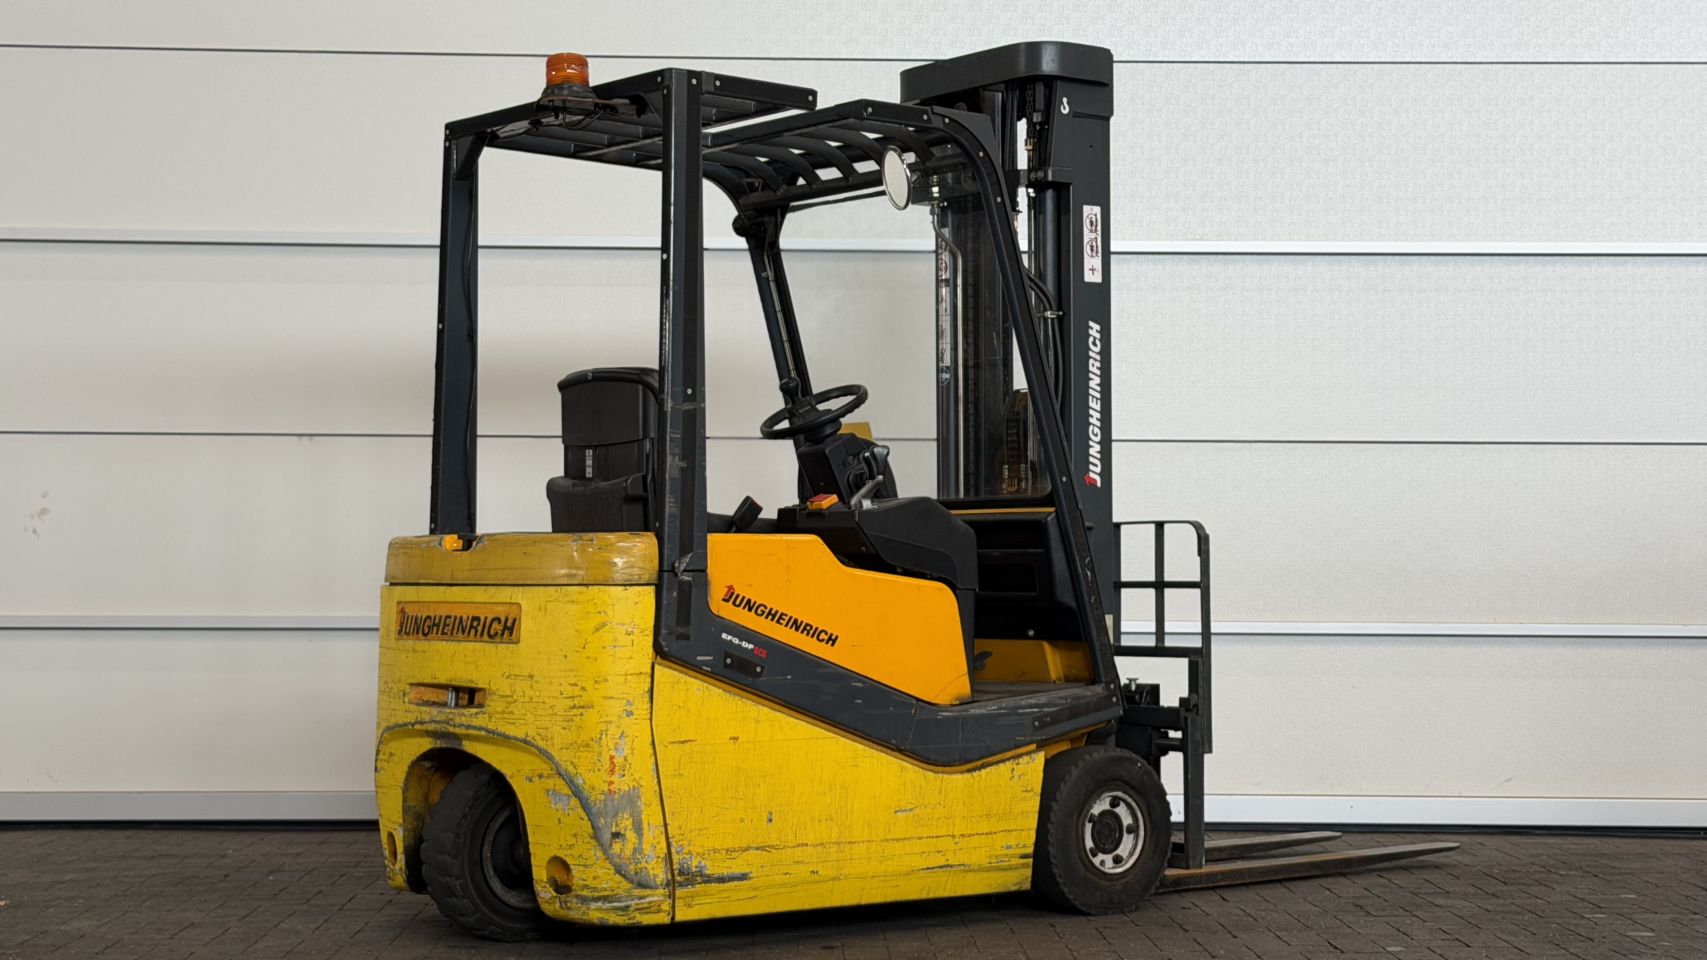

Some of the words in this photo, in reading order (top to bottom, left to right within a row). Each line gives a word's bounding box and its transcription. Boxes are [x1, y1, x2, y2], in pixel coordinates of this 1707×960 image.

[1087, 320, 1101, 488] JUNGHEINRICH
[398, 610, 517, 640] JUNGHEINRICH
[721, 585, 839, 647] JUNGHEINRICH
